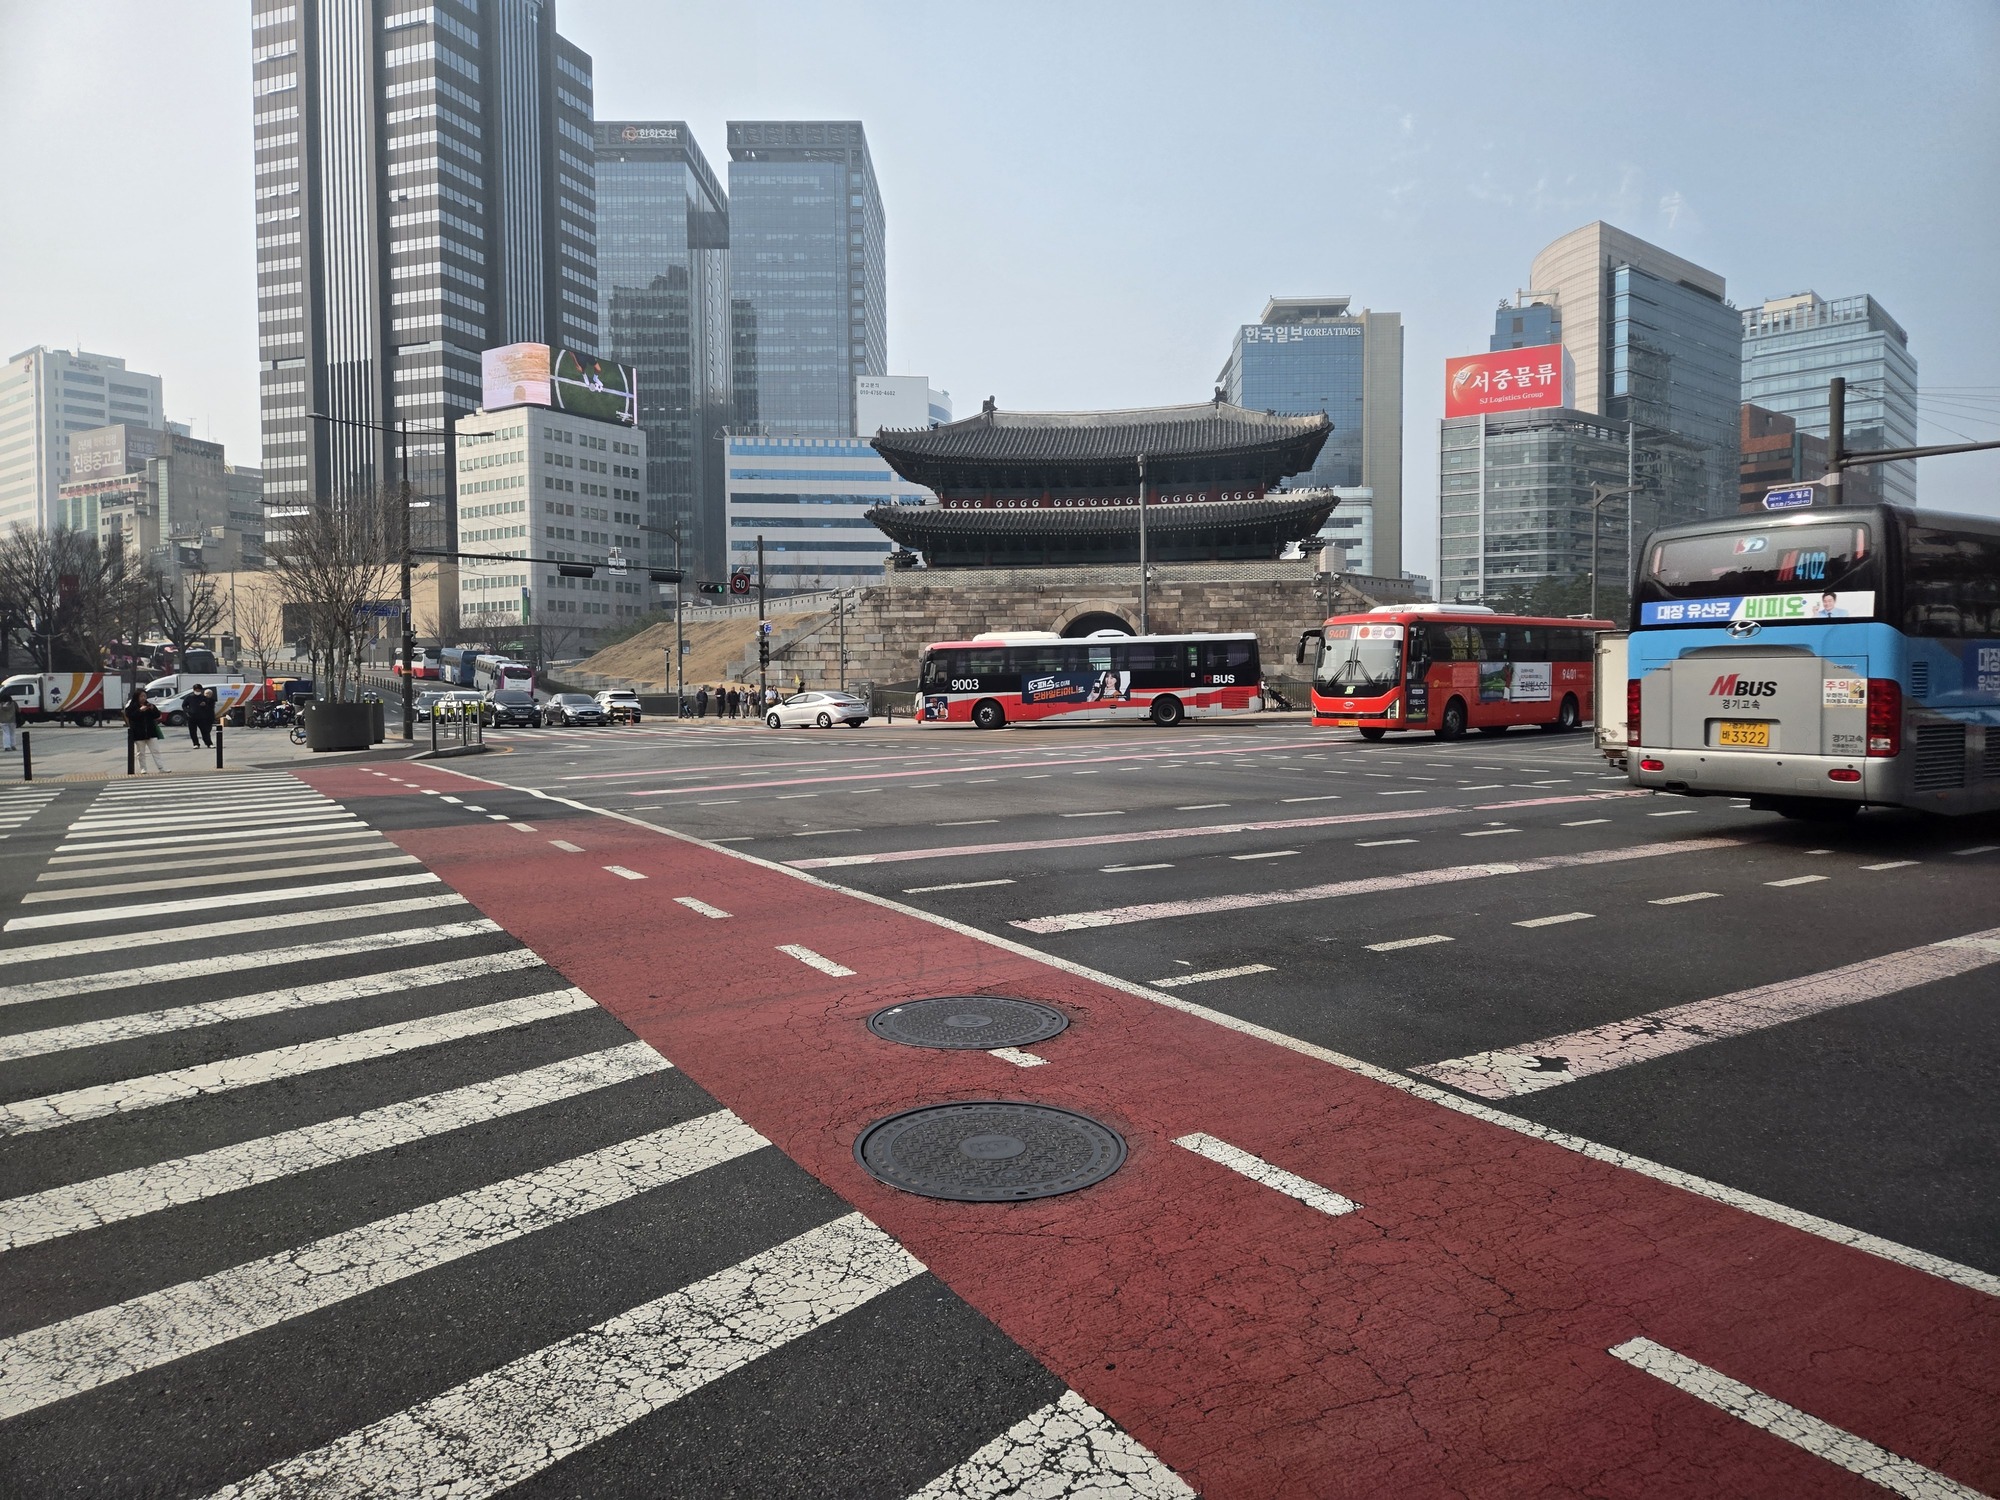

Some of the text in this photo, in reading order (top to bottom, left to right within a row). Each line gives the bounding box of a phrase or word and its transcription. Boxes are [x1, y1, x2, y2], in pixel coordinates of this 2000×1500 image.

[1244, 326, 1303, 344] 한국일보
[1470, 363, 1557, 393] 서중물류
[1479, 392, 1544, 405] SJ Logistics Group
[73, 449, 122, 473] 진형중고교
[735, 579, 745, 589] 50
[1657, 602, 1731, 620] 대장 유산균
[1745, 596, 1804, 619] 비피오
[1328, 629, 1349, 639] 9401
[1562, 668, 1577, 680] 9401
[951, 678, 979, 691] 9003
[1825, 680, 1849, 691] 주의
[1722, 699, 1761, 710] 경기고속
[1832, 734, 1864, 743] 경기고속
